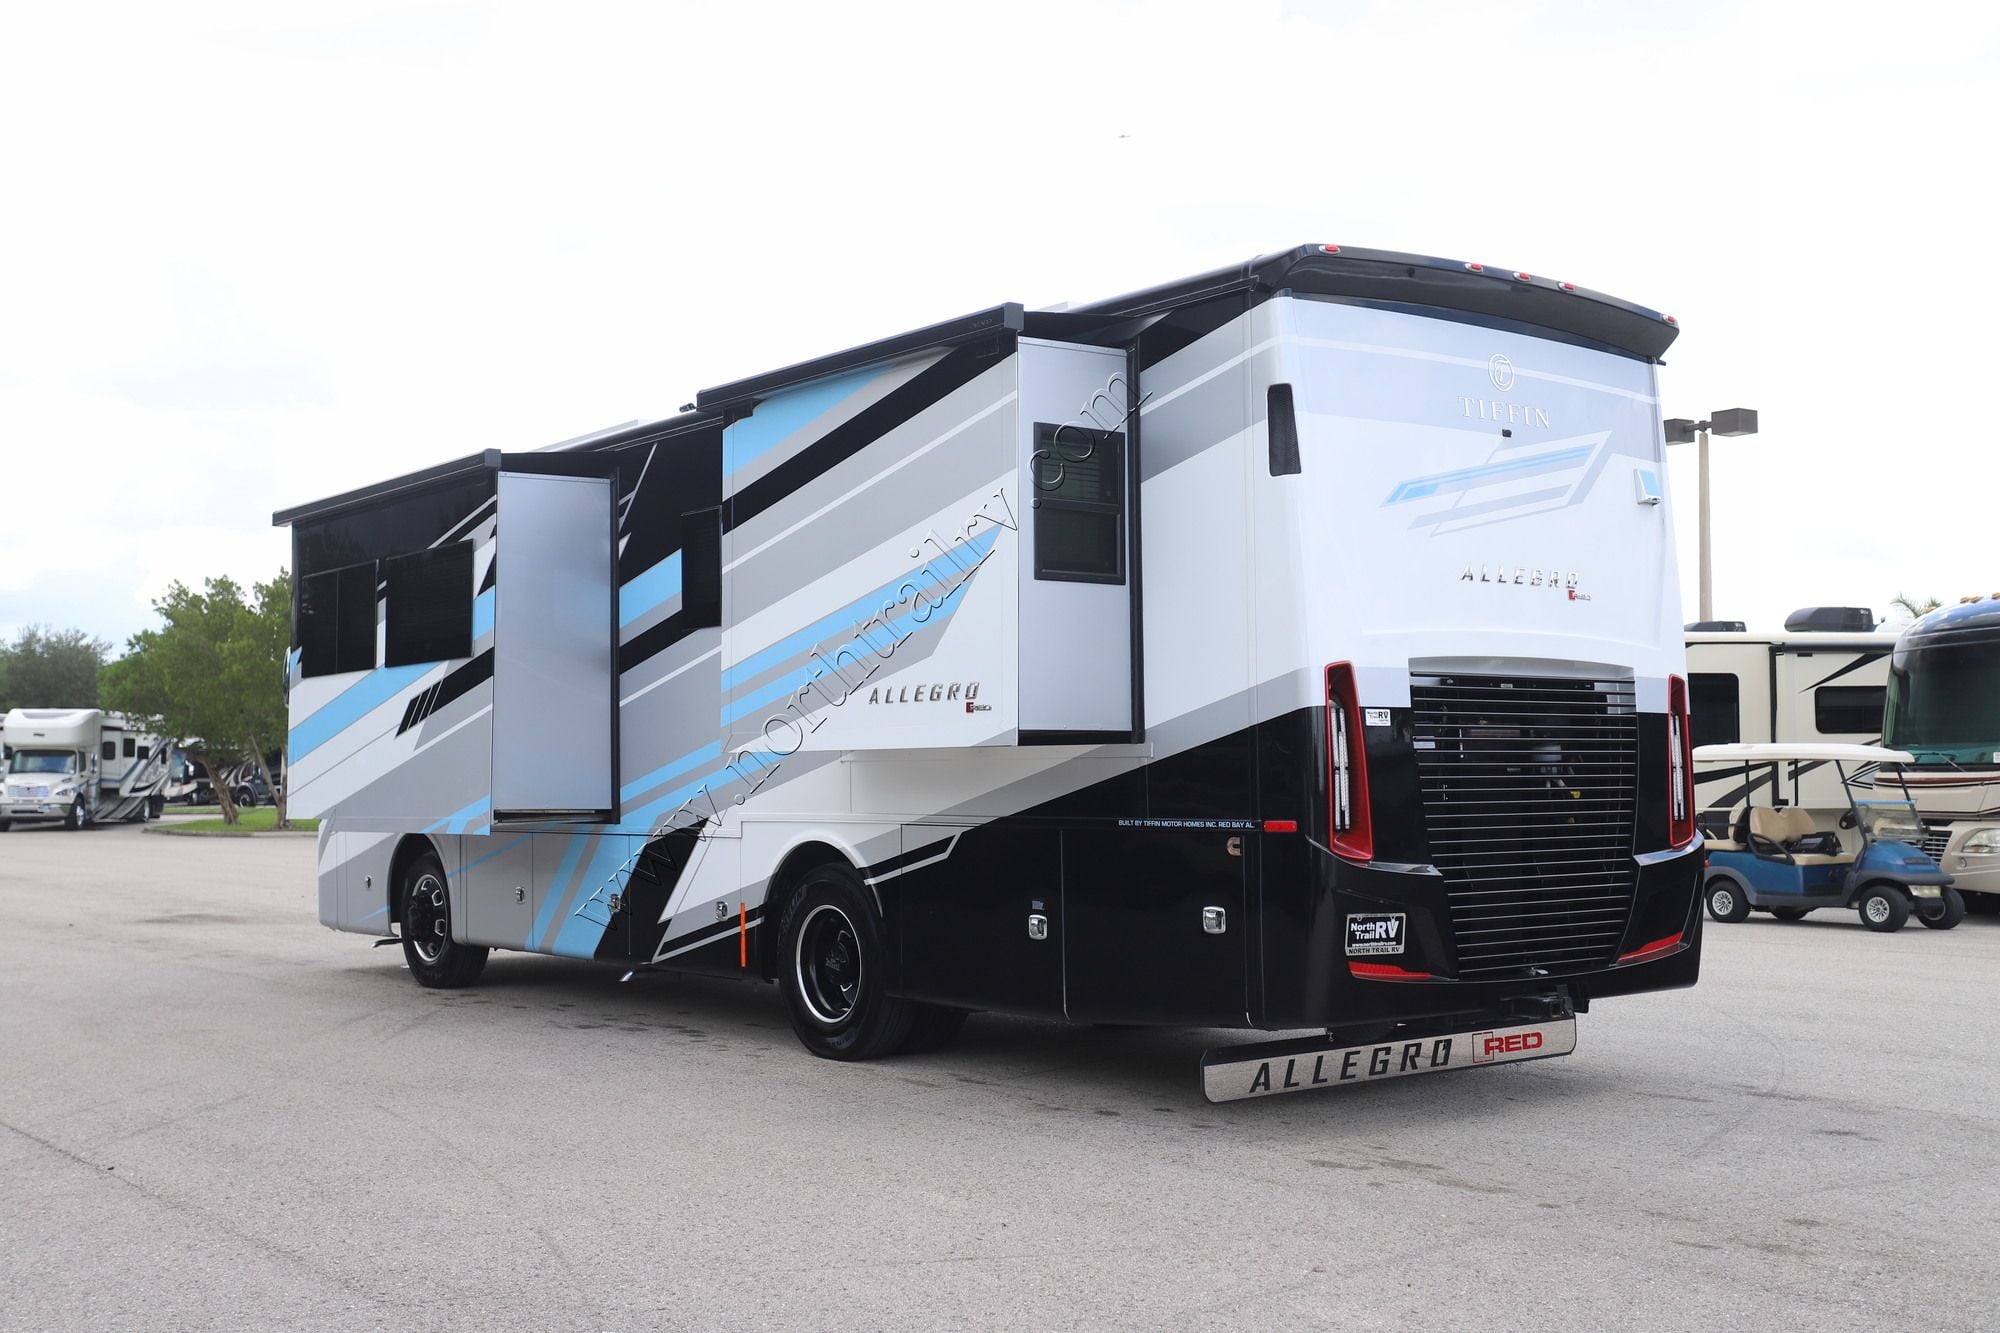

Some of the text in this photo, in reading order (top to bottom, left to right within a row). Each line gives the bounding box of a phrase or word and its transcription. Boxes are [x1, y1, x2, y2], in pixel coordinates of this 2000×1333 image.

[1457, 395, 1550, 429] TIFFIN
[1461, 561, 1579, 589] ALLEGRO
[868, 682, 980, 704] ALLEGRO
[1118, 819, 1134, 827] BUILT
[1134, 819, 1143, 827] BY
[1144, 820, 1160, 828] TIFFIN
[1161, 820, 1183, 828] MOTOR
[1183, 820, 1205, 828] HOMES
[1218, 821, 1231, 829] RED
[1231, 821, 1244, 829] BAY
[1351, 921, 1399, 939] North RV
[1355, 931, 1375, 940] Trail
[1249, 1031, 1543, 1094] ALLEGRO RED
